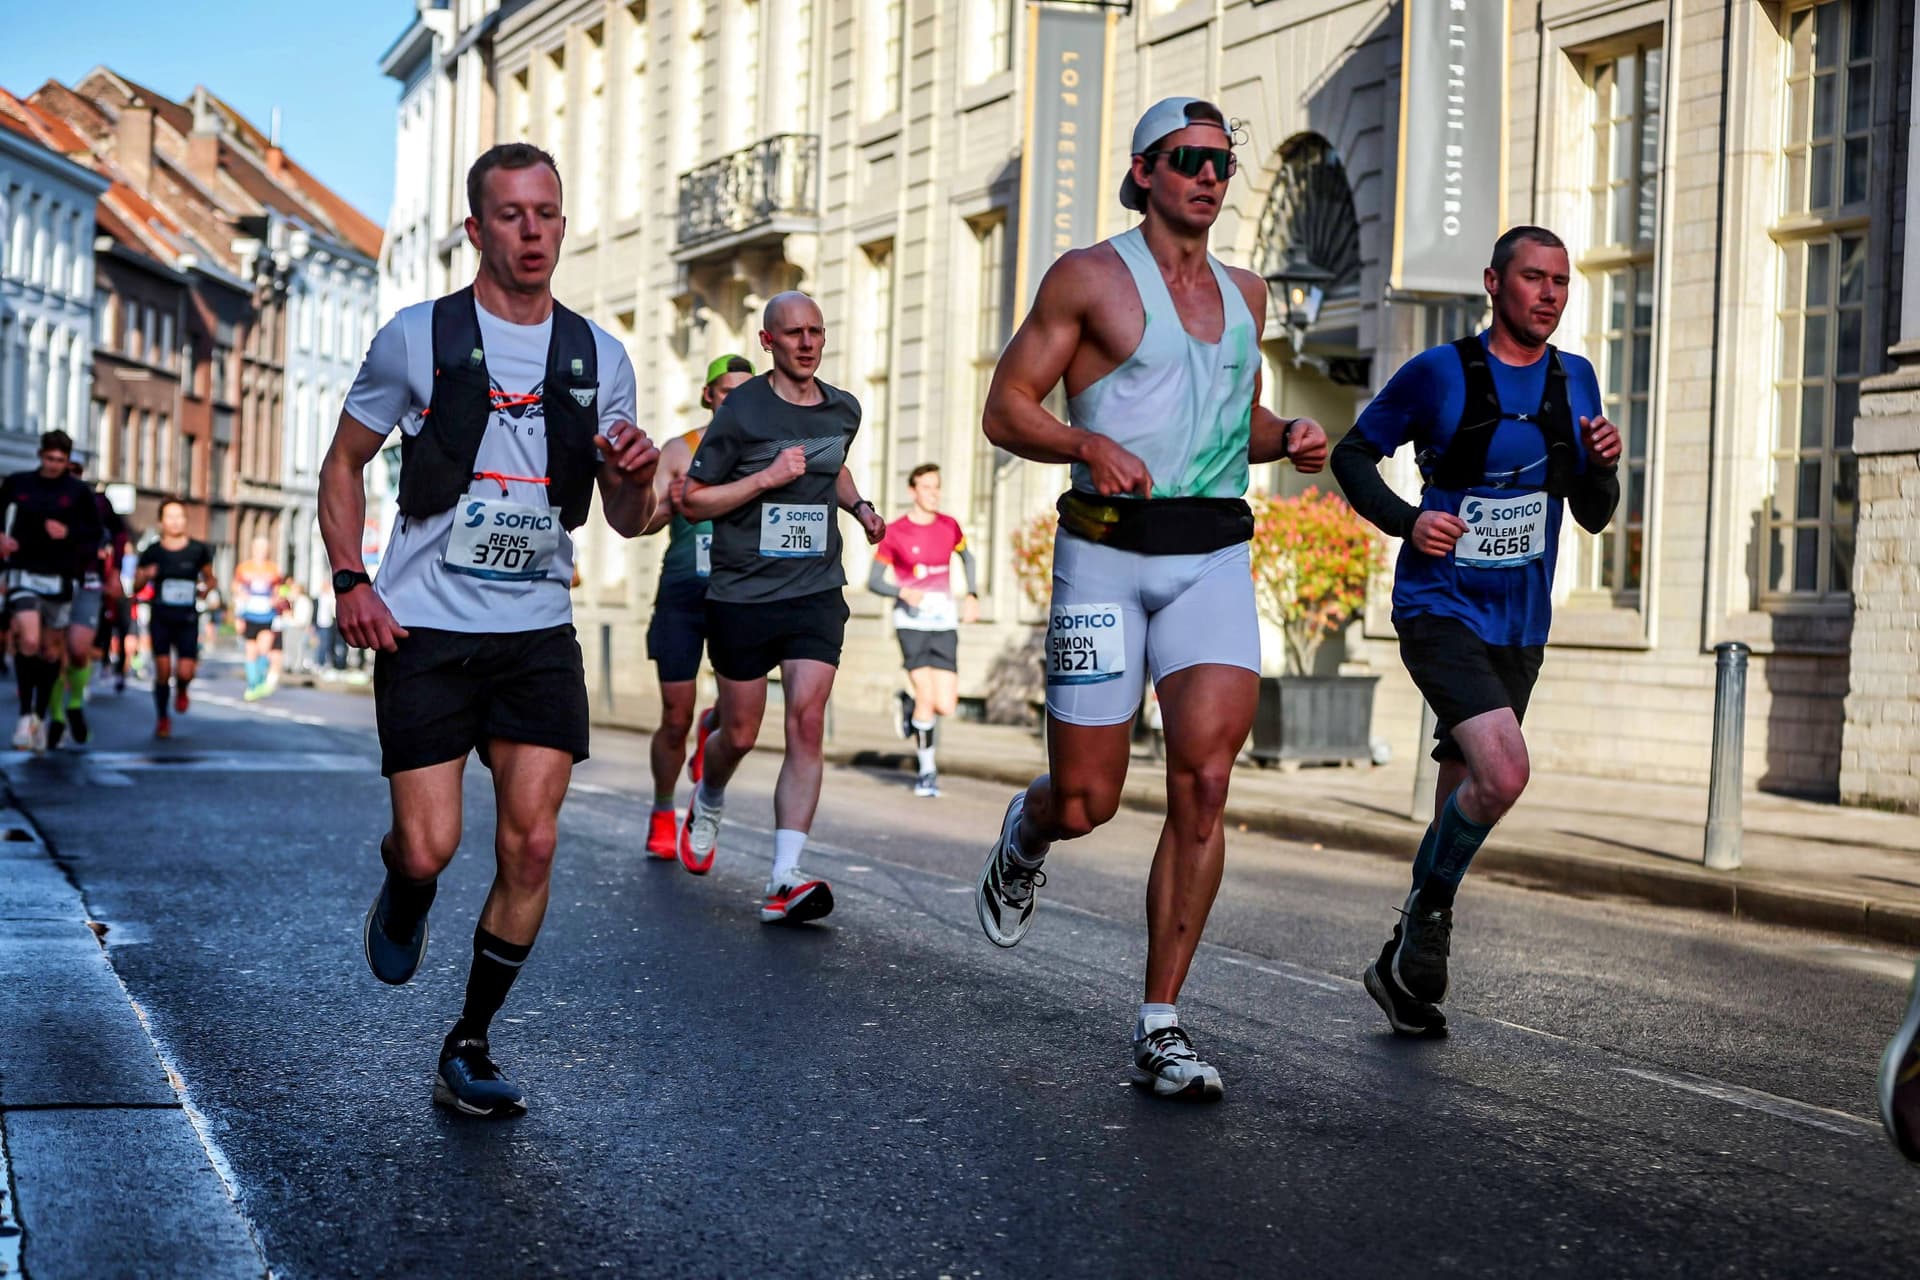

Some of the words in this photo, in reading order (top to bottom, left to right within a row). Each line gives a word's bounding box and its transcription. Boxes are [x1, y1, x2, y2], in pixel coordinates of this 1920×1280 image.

[1055, 120, 1077, 259] RESTAUR
[1442, 145, 1463, 236] BISTRO
[786, 511, 824, 522] SOFICO
[1491, 502, 1542, 520] SOFICO
[789, 526, 806, 535] TIM
[1474, 526, 1517, 538] WILLEM
[1518, 522, 1535, 535] JAN
[488, 532, 530, 549] RENS
[780, 535, 812, 549] 2118
[1477, 535, 1530, 557] 4658
[472, 545, 536, 570] 3707
[1053, 613, 1116, 630] SOFICO
[1052, 636, 1094, 650] SIMON
[1052, 649, 1099, 672] 3621
